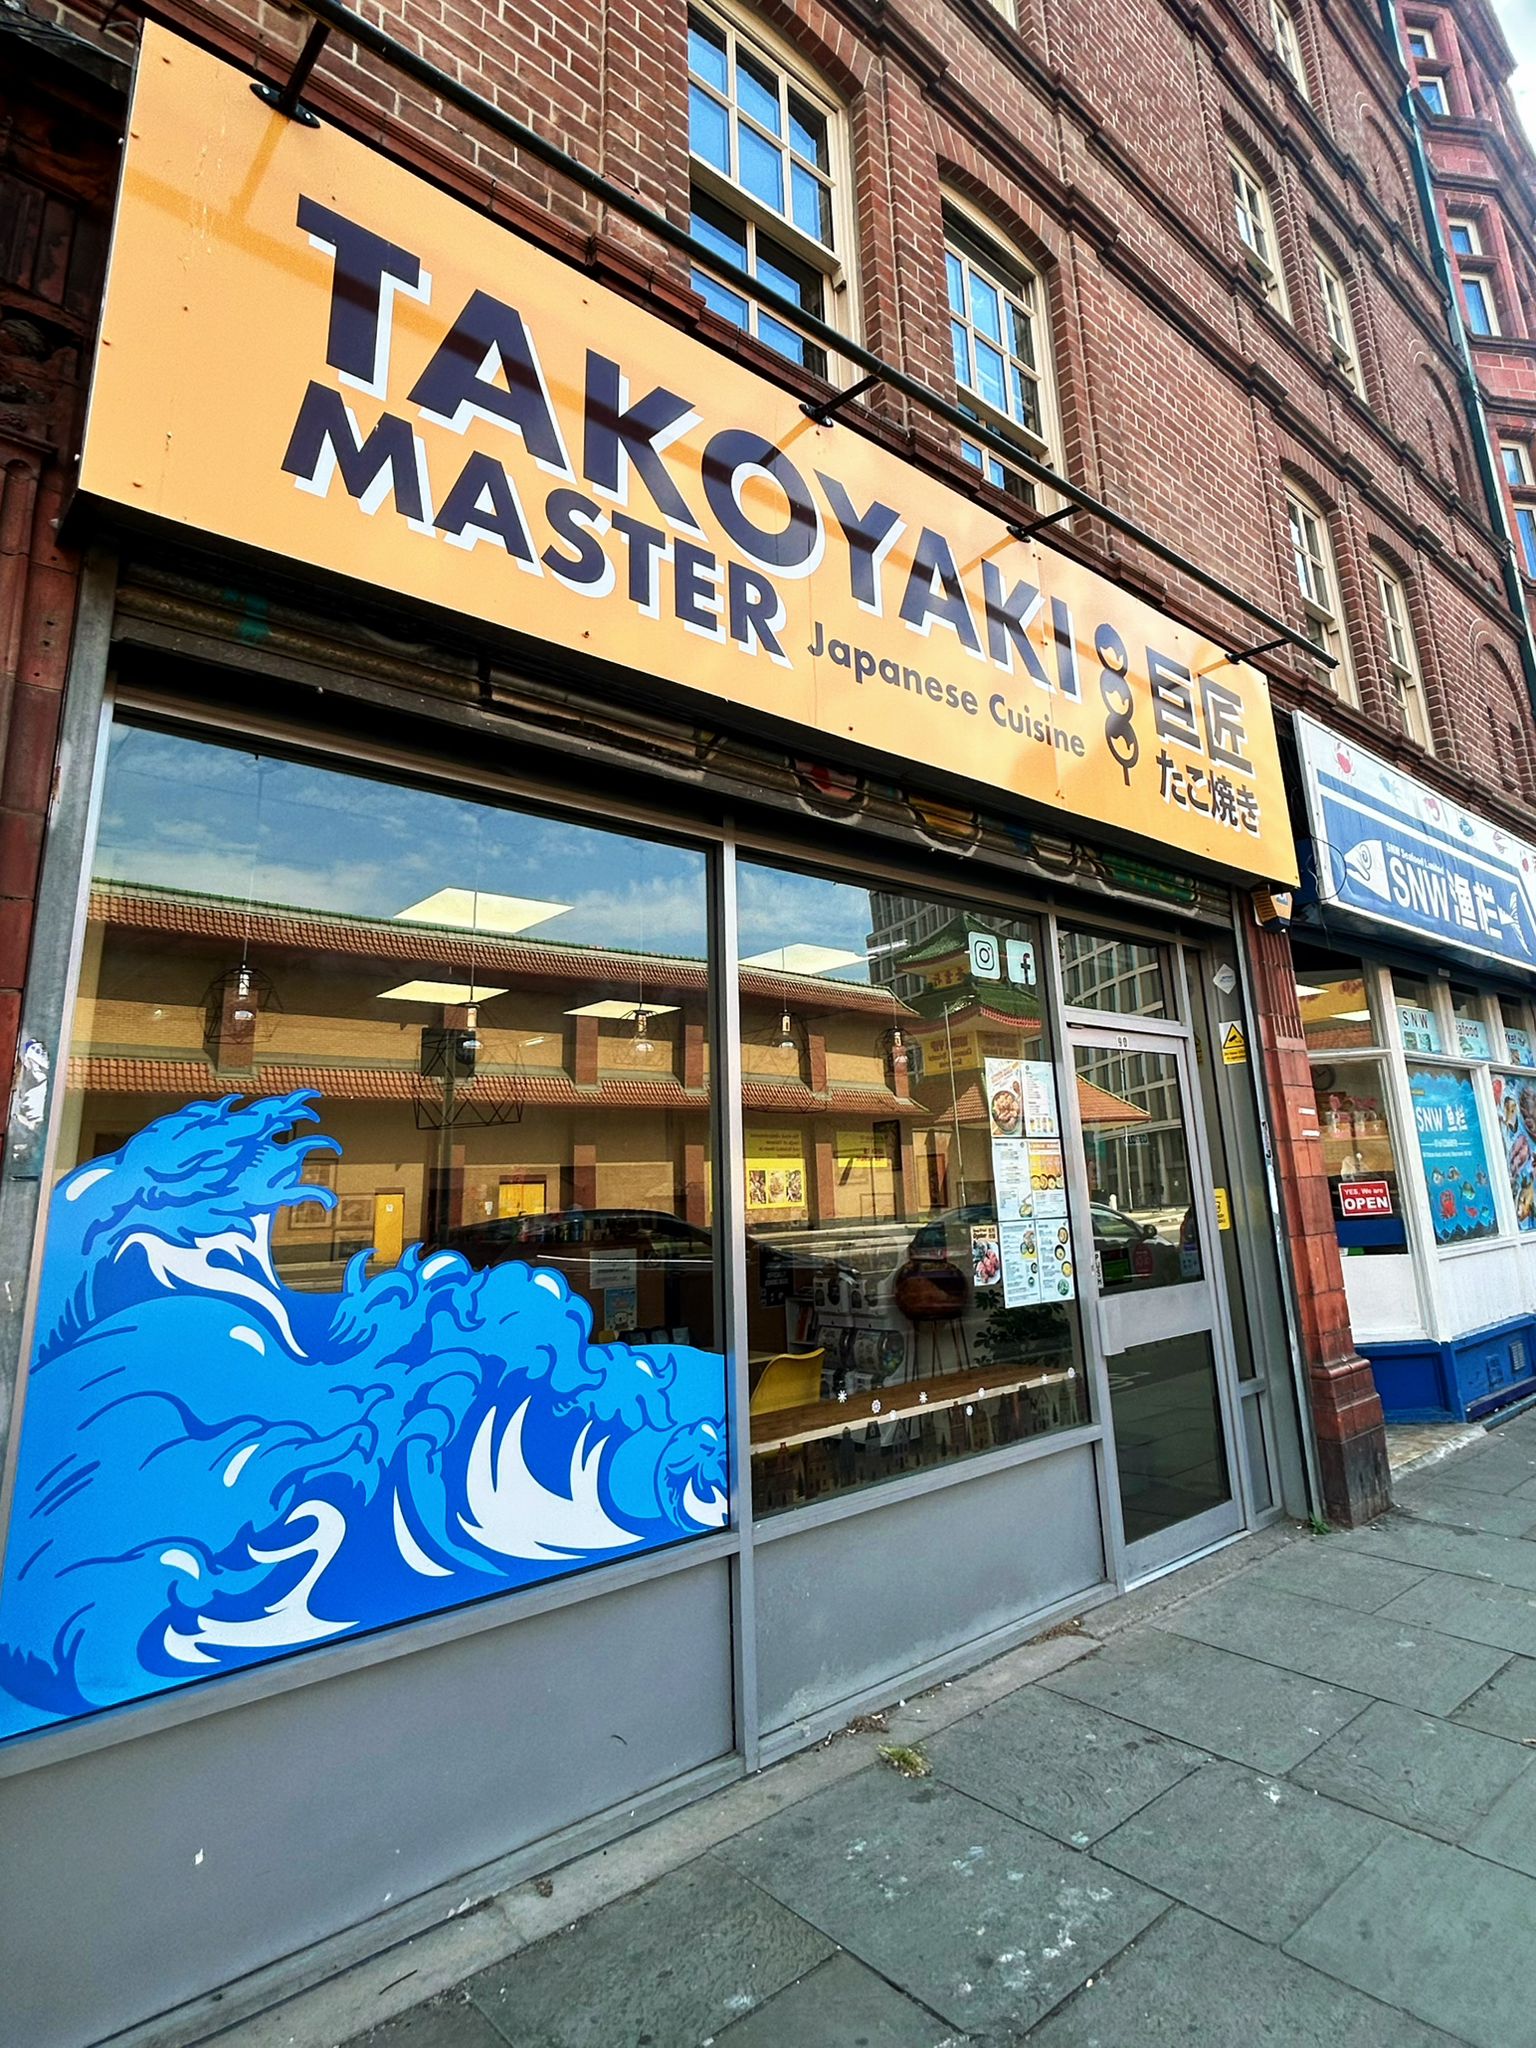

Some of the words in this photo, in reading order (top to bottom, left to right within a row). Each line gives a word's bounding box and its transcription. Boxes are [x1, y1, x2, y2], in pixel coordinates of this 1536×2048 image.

[296, 193, 1082, 704] TAKOYAKI
[280, 379, 794, 670] MASTER
[807, 621, 979, 715] Japanese
[988, 693, 1086, 758] Cuisine
[1145, 645, 1257, 780] 巨匠
[1155, 747, 1262, 839] たこ焼き
[1402, 1010, 1429, 1030] SNW
[1415, 1105, 1443, 1133] SNW
[1344, 1196, 1389, 1211] OPEN
[1361, 1187, 1372, 1195] We
